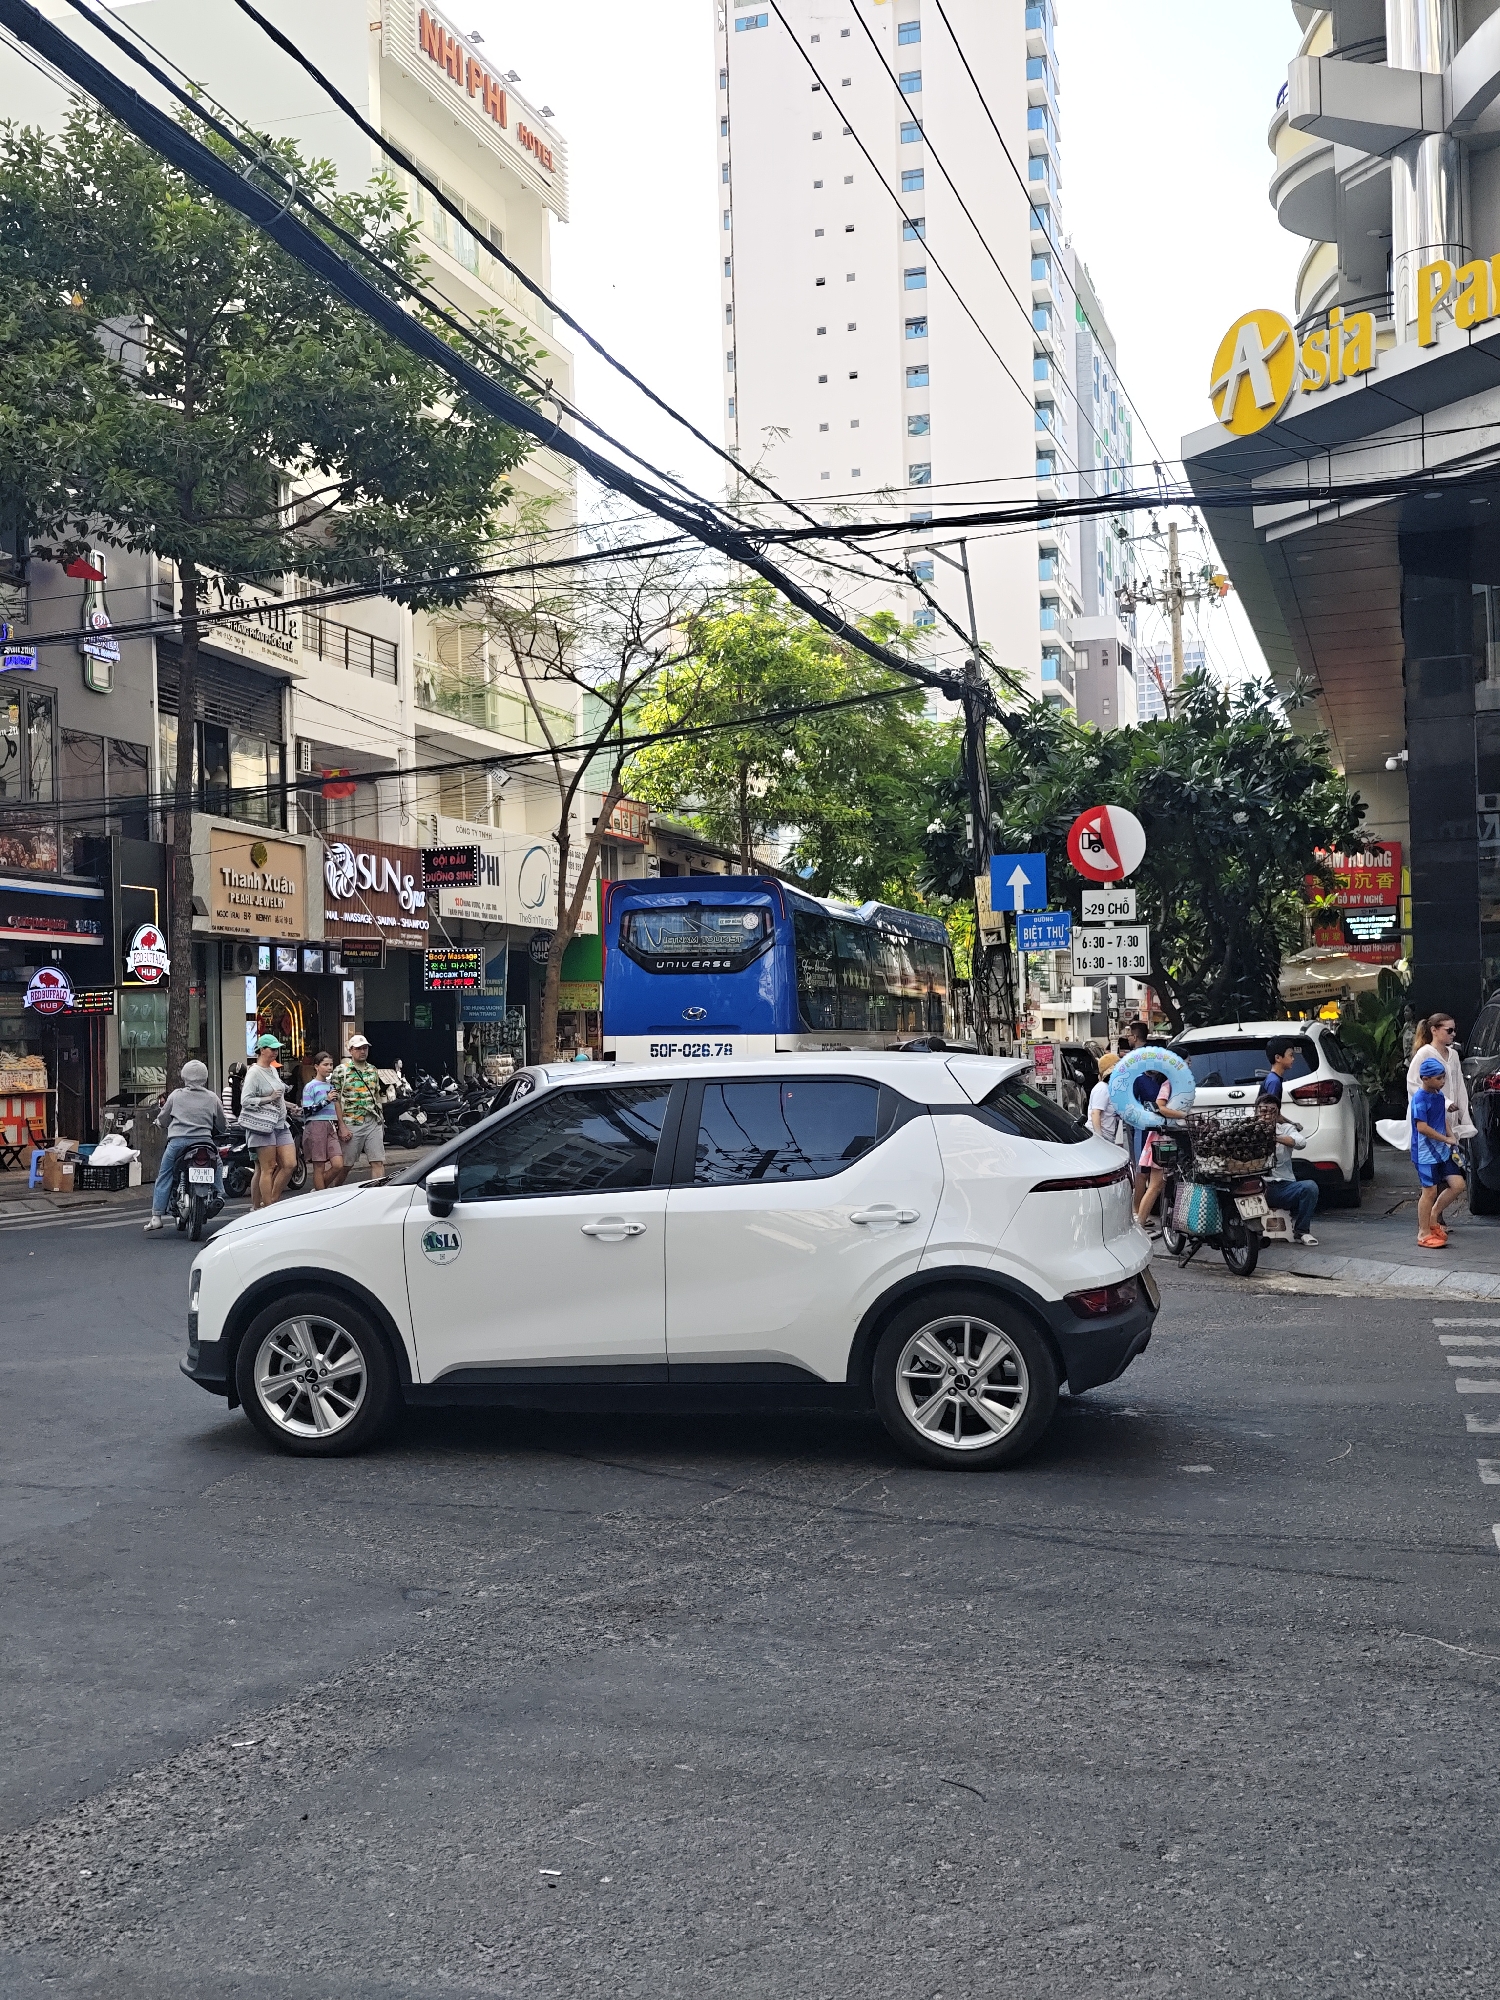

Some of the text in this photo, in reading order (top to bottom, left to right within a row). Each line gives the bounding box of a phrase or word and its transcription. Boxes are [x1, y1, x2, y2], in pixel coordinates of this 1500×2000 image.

[420, 8, 557, 173] NHI PHI HOTEL
[1417, 252, 1500, 349] Pa
[221, 867, 296, 895] Thanh Xuân
[355, 853, 401, 894] SUN
[229, 892, 286, 909] PEARL JEWELRY
[399, 874, 427, 914] Spa
[1085, 897, 1130, 915] >29 CHỖ
[1023, 923, 1065, 942] BIỆT THỰ
[531, 942, 552, 952] MIN
[1082, 937, 1105, 949] 6:30
[1116, 935, 1139, 947] 7:30
[429, 953, 478, 962] Body Massage
[656, 960, 731, 968] UNIVERSE
[1077, 957, 1105, 969] 16:30
[1117, 955, 1145, 968] 18:30
[141, 967, 157, 976] HUB
[428, 970, 478, 979] Массаж Тела
[650, 1043, 733, 1058] 50F-026.78
[424, 1233, 460, 1248] ASIA
